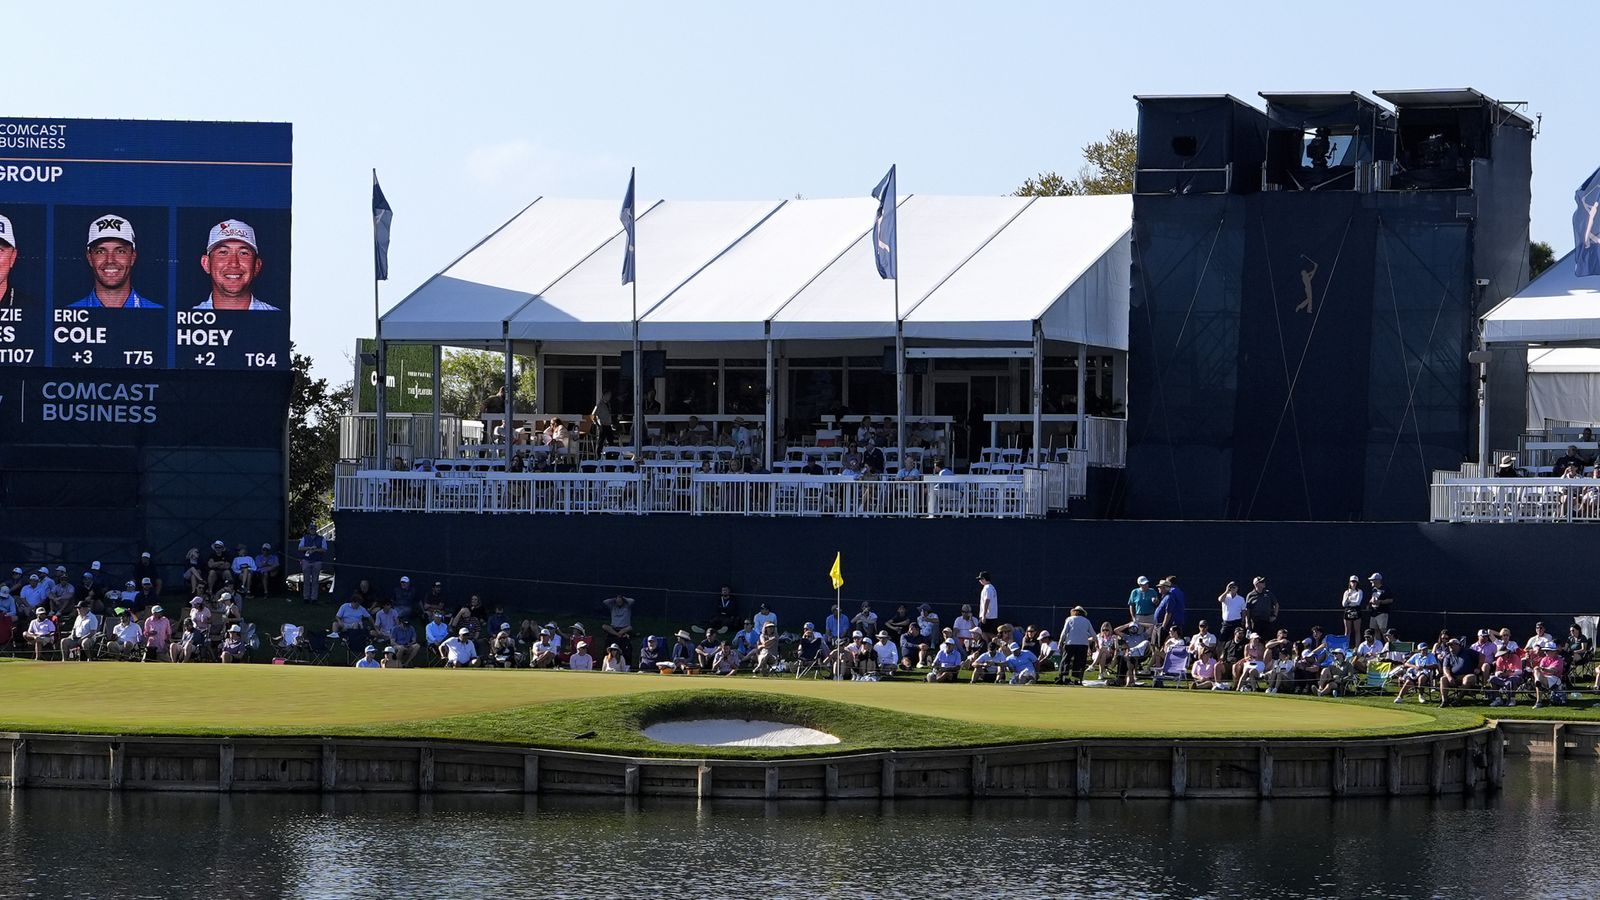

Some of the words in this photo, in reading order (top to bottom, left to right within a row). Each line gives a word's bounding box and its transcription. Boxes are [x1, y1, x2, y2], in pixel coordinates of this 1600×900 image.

[0, 124, 67, 136] COMCAST
[0, 137, 66, 149] BUSINESS
[54, 309, 89, 322] ERIC
[177, 311, 216, 324] RICO
[54, 327, 107, 343] COLE
[177, 329, 233, 346] HOEY
[0, 349, 34, 363] T107
[72, 350, 93, 364] +3
[123, 351, 153, 365] T75
[195, 352, 216, 366] +2
[245, 353, 277, 367] T64
[42, 382, 159, 401] COMCAST
[42, 403, 157, 423] BUSINESS
